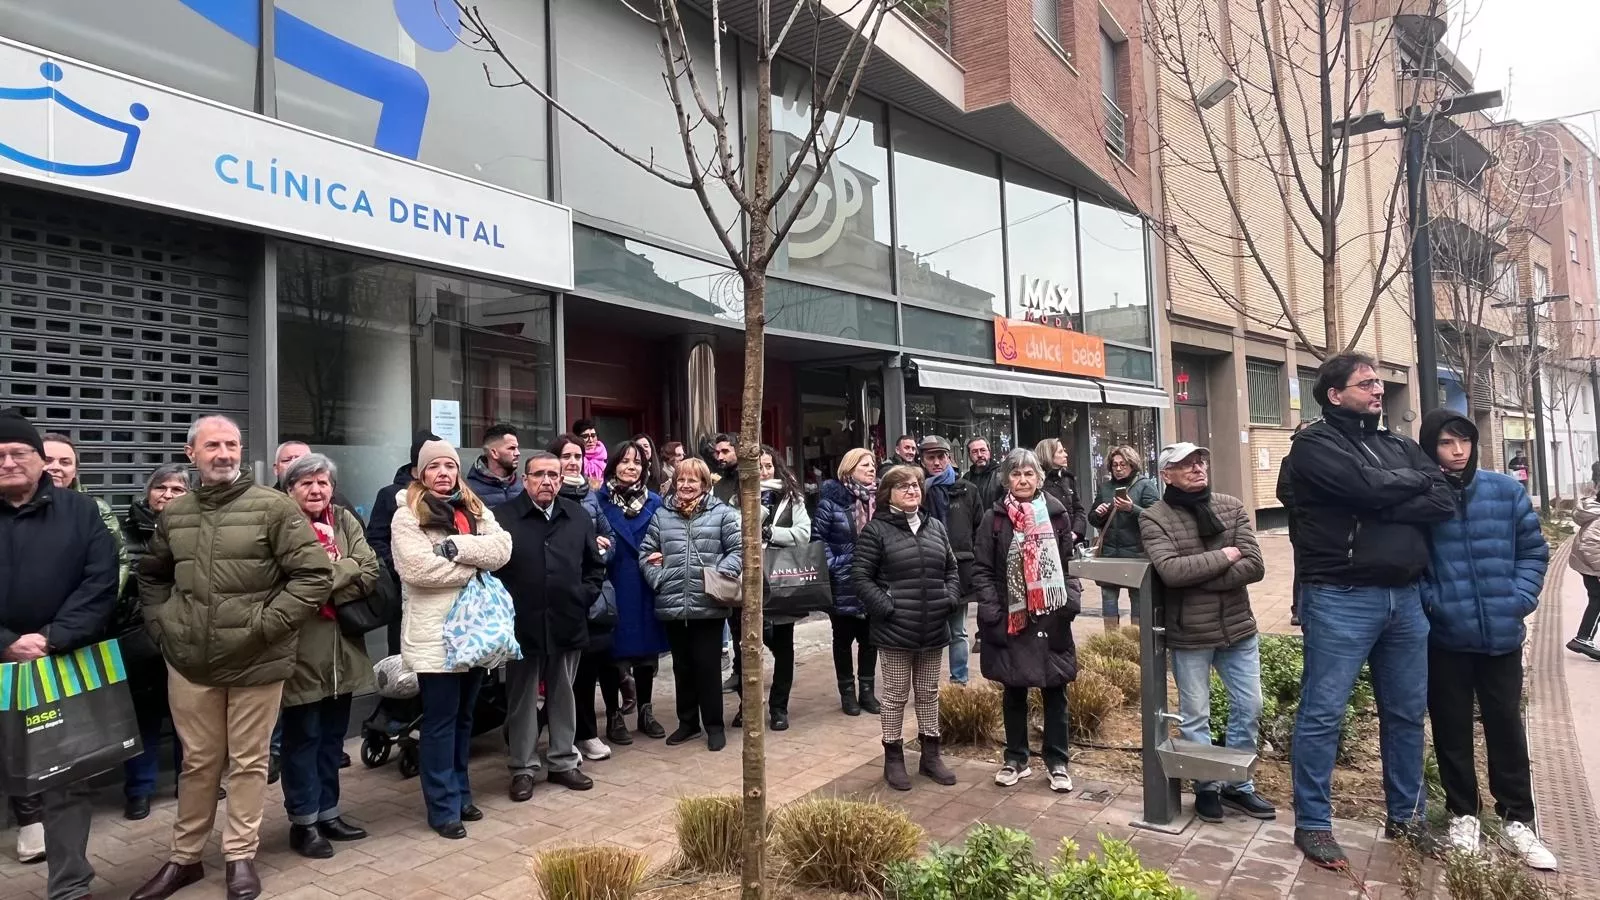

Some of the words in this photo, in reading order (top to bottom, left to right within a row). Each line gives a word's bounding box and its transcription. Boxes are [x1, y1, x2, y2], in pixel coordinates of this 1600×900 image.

[215, 154, 374, 217] CLÍNICA
[390, 197, 504, 248] DENTAL
[1021, 273, 1073, 316] MAX
[1025, 310, 1073, 330] MODA
[1026, 333, 1063, 363] dulce
[1072, 339, 1102, 368] bebé
